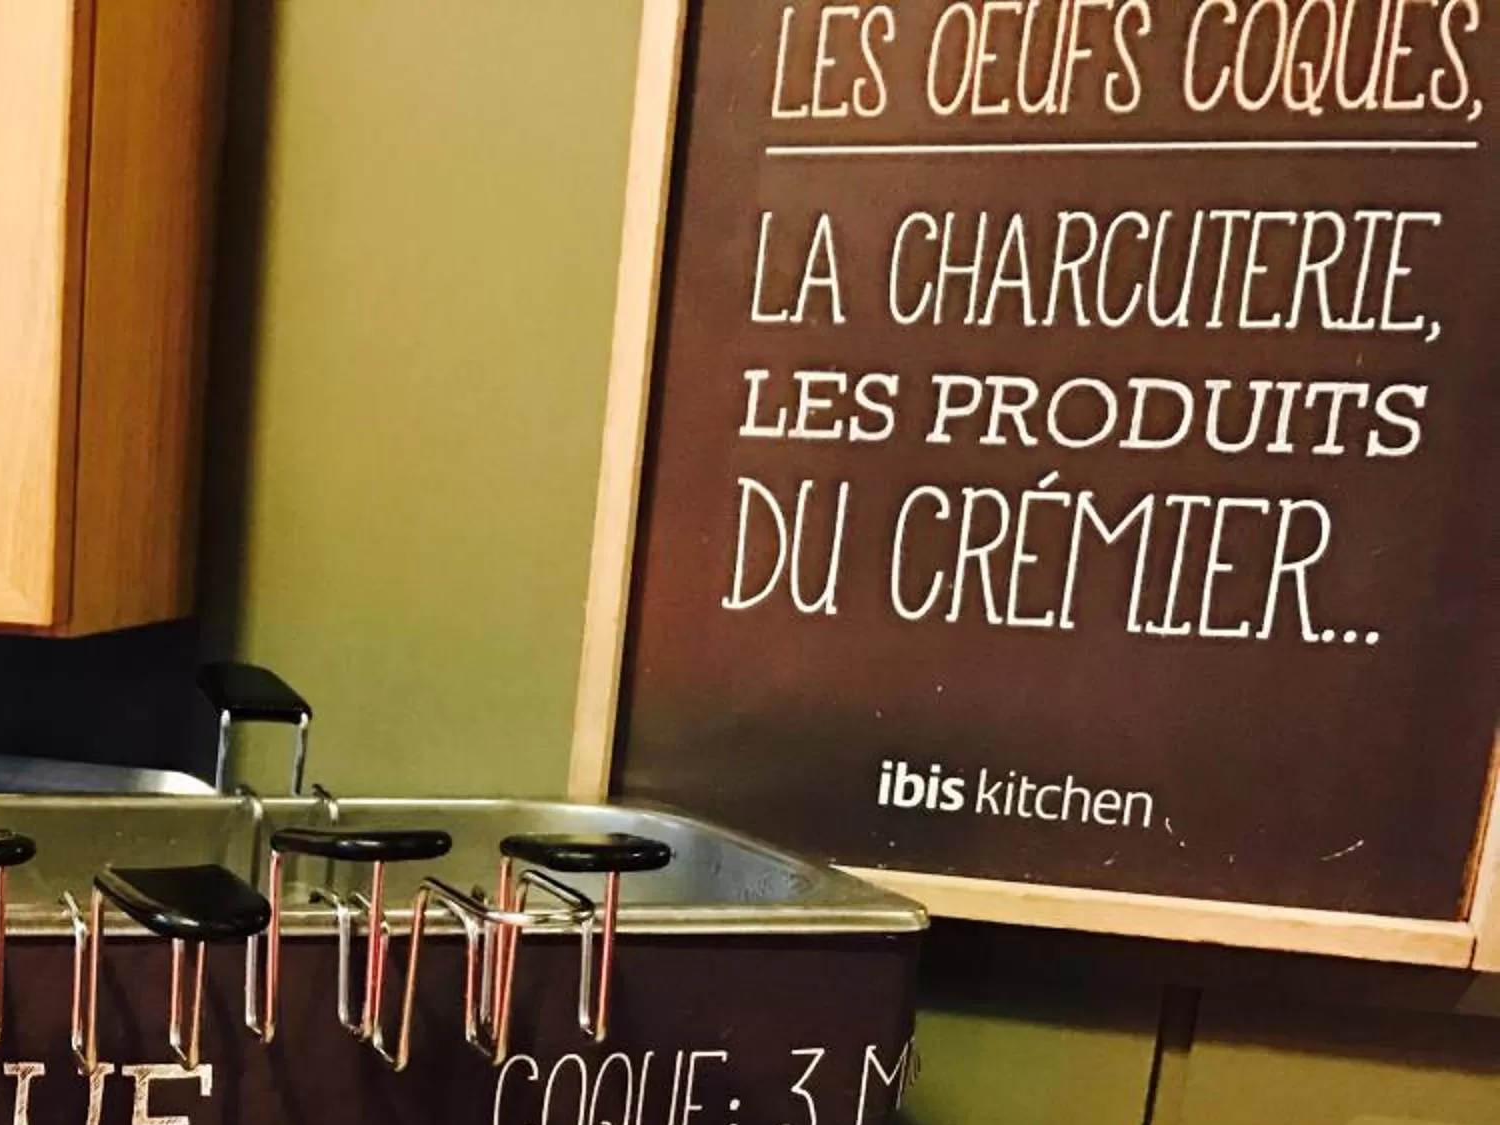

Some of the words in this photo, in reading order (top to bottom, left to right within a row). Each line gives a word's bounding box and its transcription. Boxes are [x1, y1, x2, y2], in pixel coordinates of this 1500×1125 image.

[771, 4, 896, 119] LES
[927, 0, 1151, 115] OEUFS
[1183, 0, 1484, 122] COQUES,
[750, 211, 847, 326] LA
[888, 210, 1442, 344] CHARCUTERIE,
[739, 368, 900, 444] LES
[925, 373, 1430, 458] PRODUITS
[721, 476, 850, 616] DU
[889, 470, 1381, 646] CRÉMIER...
[876, 760, 966, 812] ibis
[975, 767, 1154, 830] kitchen
